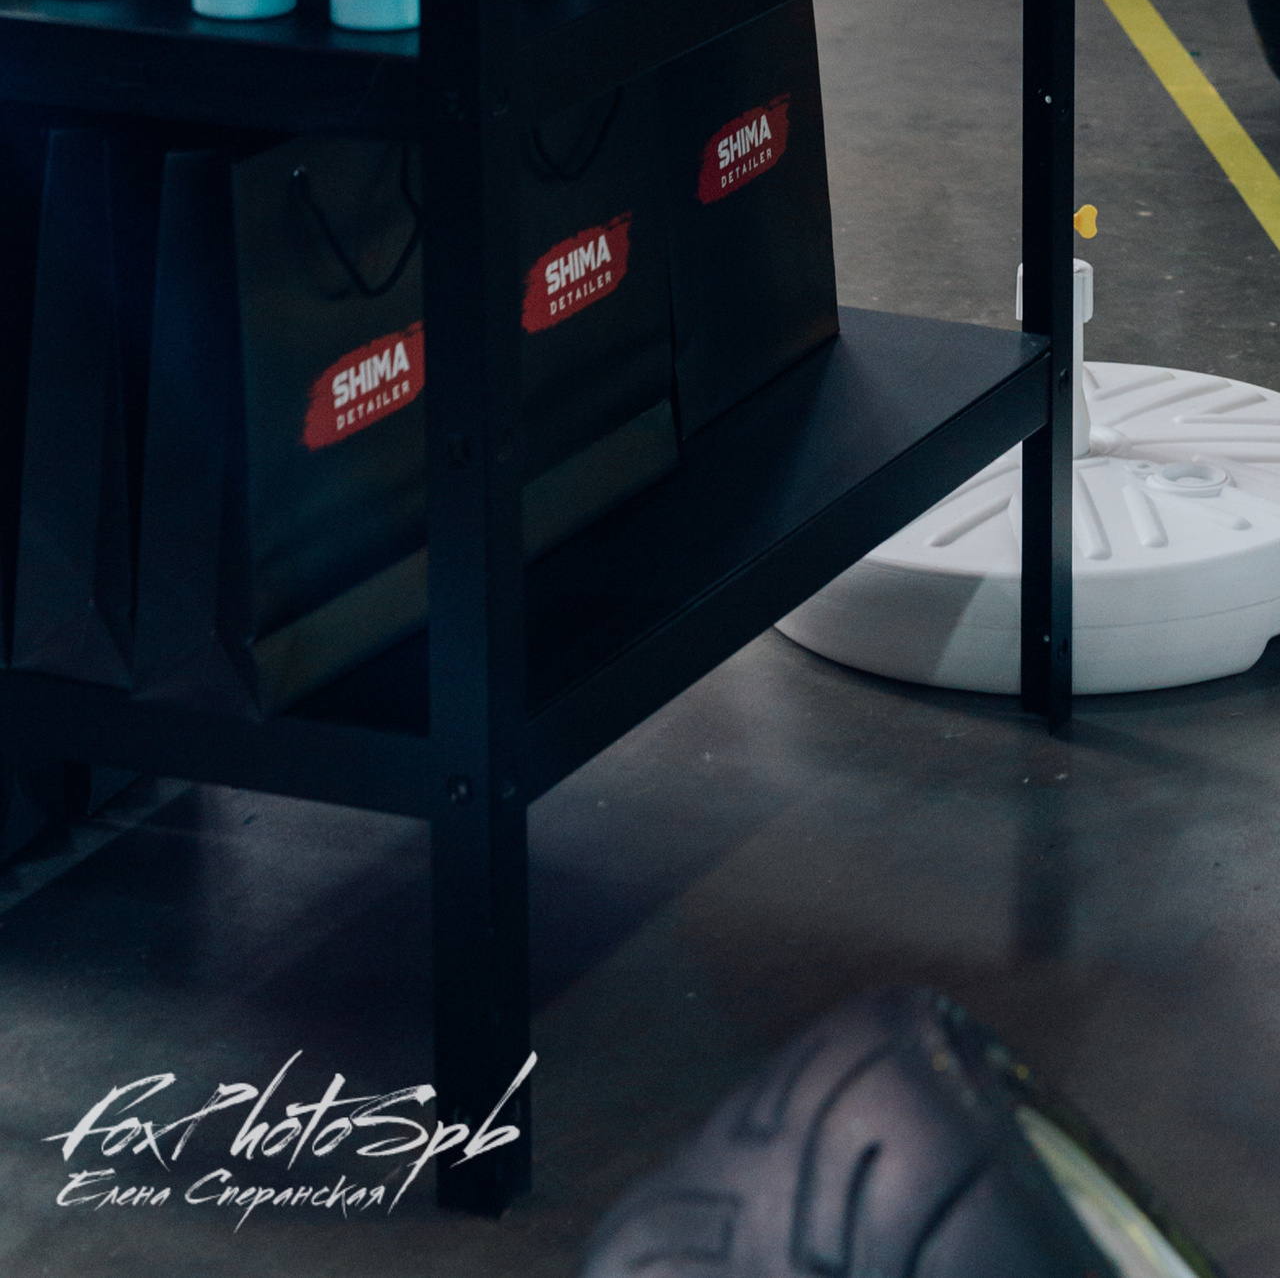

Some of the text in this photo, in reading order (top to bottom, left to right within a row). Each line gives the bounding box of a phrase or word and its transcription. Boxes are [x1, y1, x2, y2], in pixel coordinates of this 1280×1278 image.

[716, 113, 773, 170] SHIMA
[719, 146, 774, 190] DETAILER
[544, 233, 613, 296] SHIMA
[549, 269, 613, 317] DETAILER
[331, 340, 411, 410] SHIMA
[336, 378, 412, 432] DETAILER
